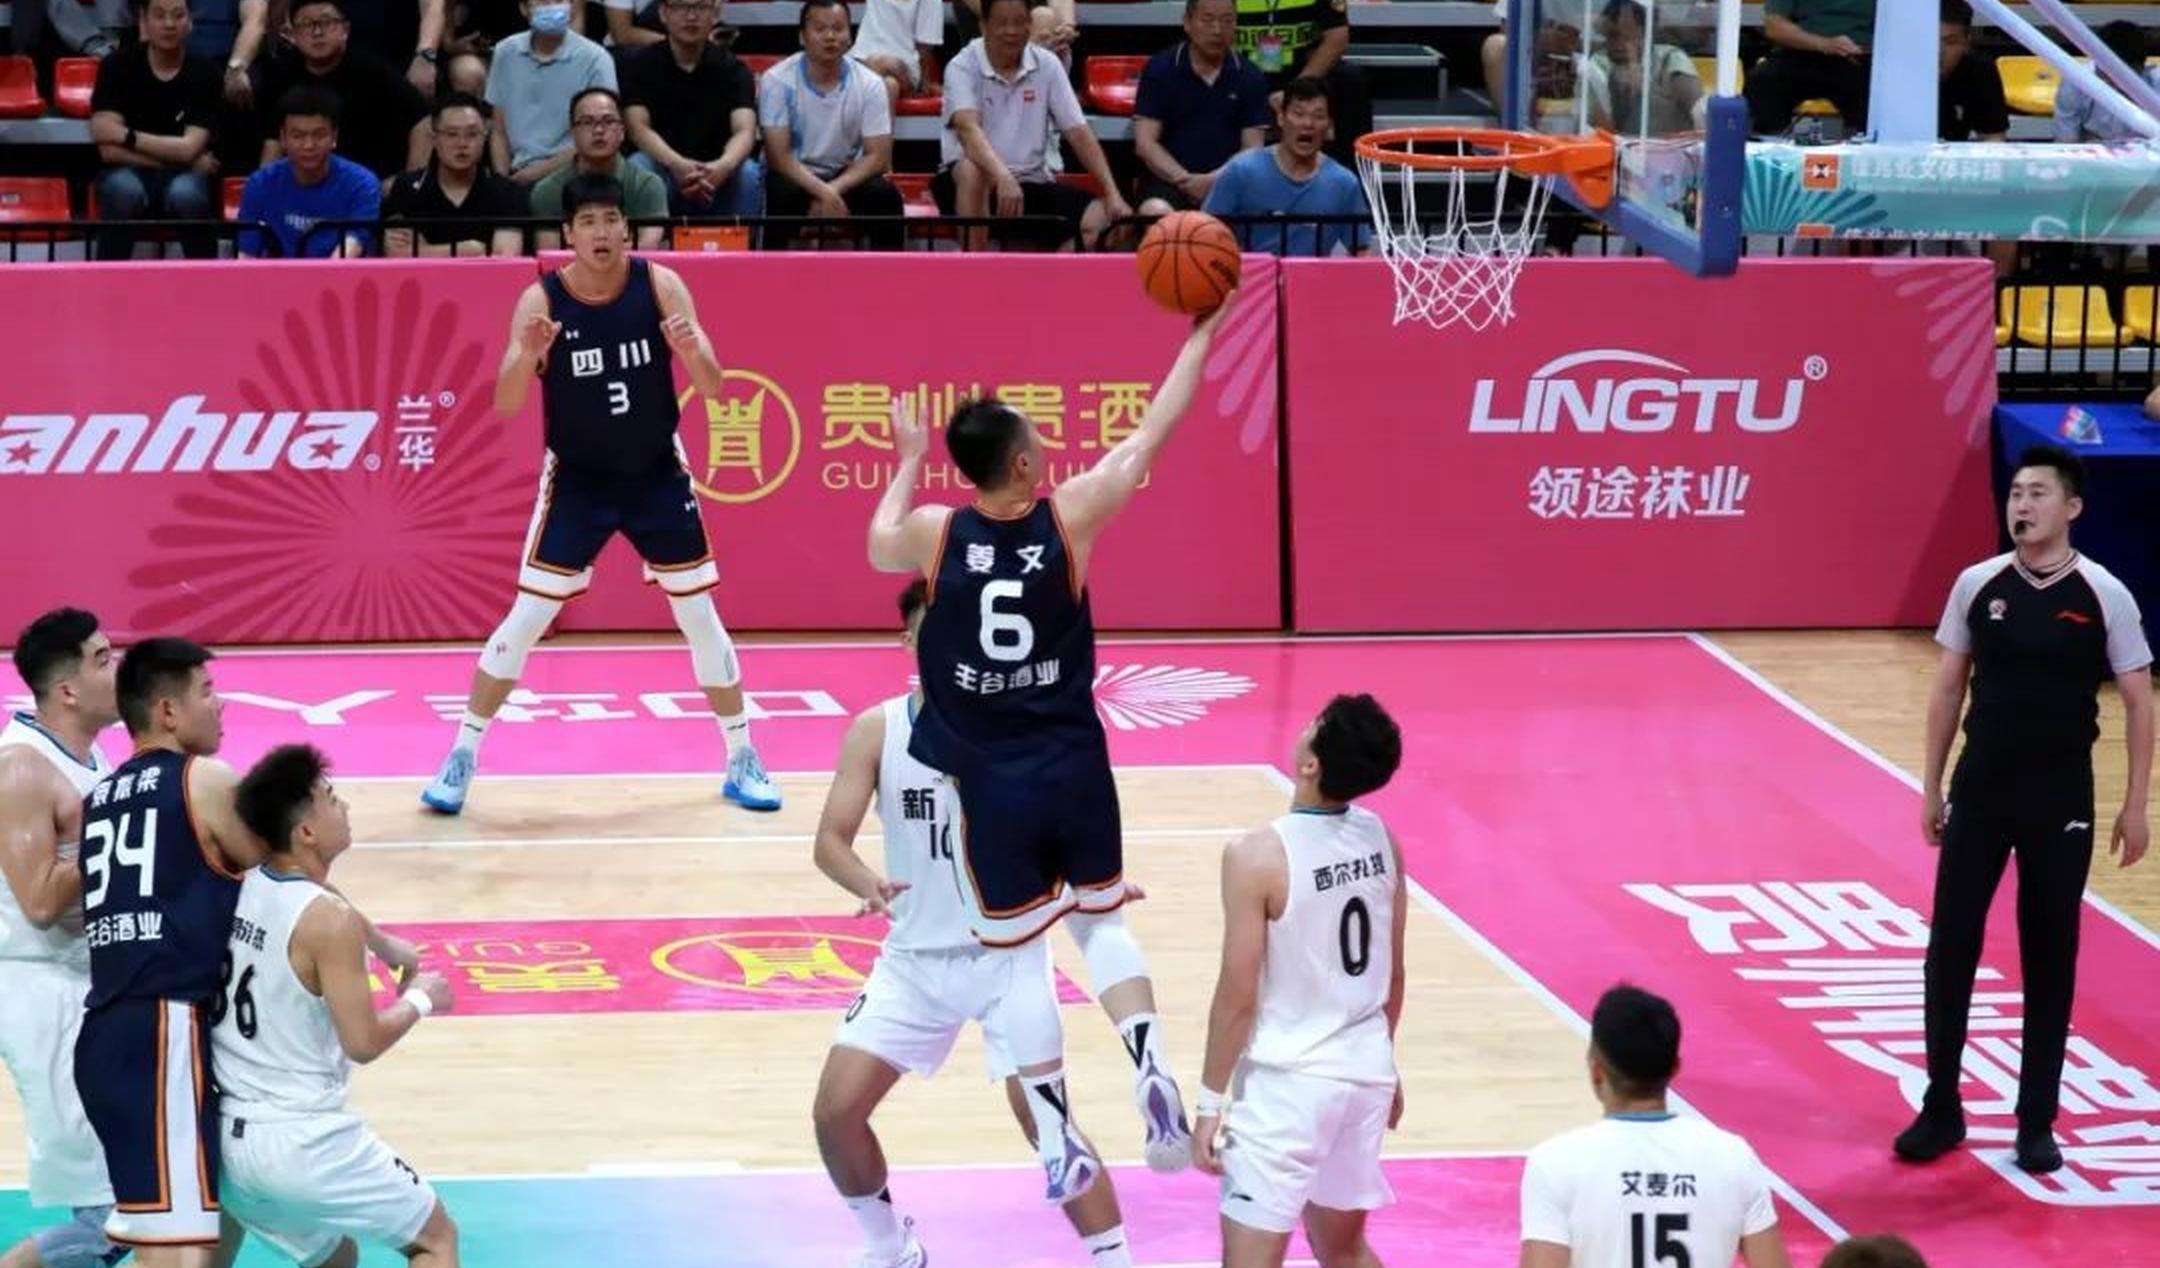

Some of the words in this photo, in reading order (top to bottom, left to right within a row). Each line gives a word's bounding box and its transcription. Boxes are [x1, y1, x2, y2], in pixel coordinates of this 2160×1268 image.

[571, 338, 652, 378] 四川
[607, 381, 631, 416] 3
[1468, 377, 1806, 434] LINGTU
[394, 394, 438, 473] 兰华
[1528, 465, 1751, 520] 领途袜业
[979, 579, 1035, 662] 6
[901, 787, 936, 821] 新
[84, 808, 158, 911] 34
[1339, 895, 1372, 977] 0
[1630, 1211, 1692, 1268] 15
